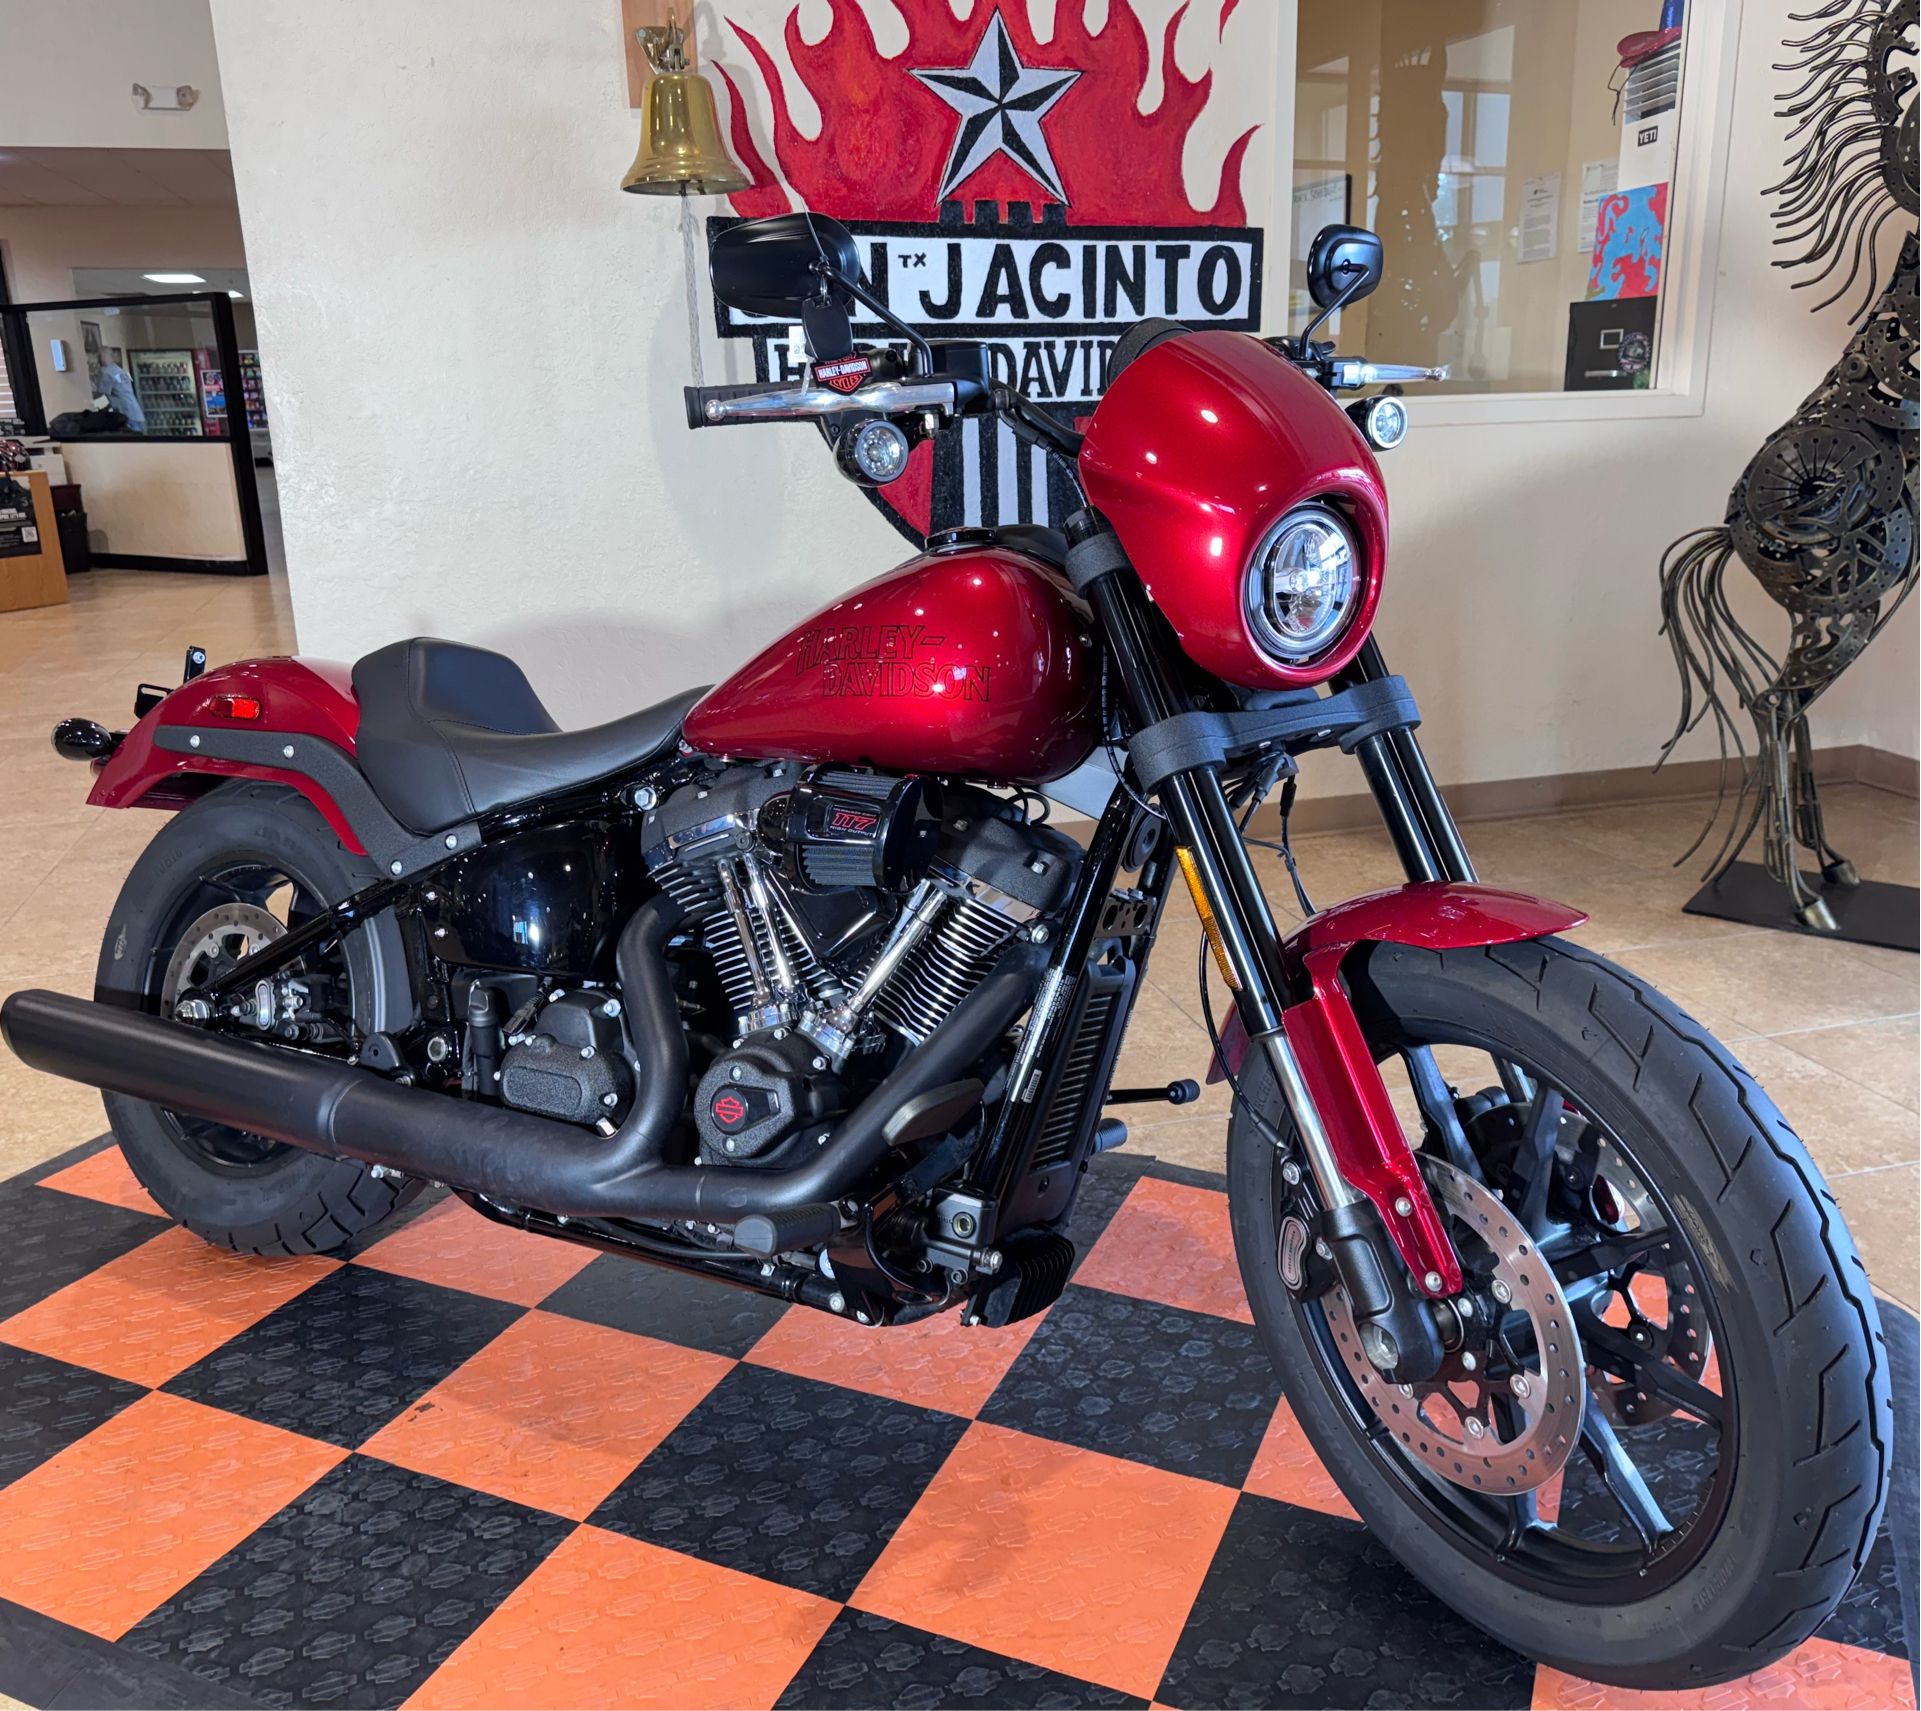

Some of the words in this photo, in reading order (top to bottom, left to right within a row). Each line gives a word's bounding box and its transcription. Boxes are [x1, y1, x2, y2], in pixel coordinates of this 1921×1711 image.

[1639, 128, 1657, 145] YETI
[898, 252, 927, 268] TX
[918, 242, 1242, 320] JACINTO
[817, 360, 868, 379] HARLEY-DAVIDSON
[832, 375, 859, 389] CYCLES
[795, 625, 946, 677] HARLEY-
[822, 662, 991, 702] DAVIDSON
[831, 812, 877, 830] 117
[847, 828, 876, 837] OUTPUT
